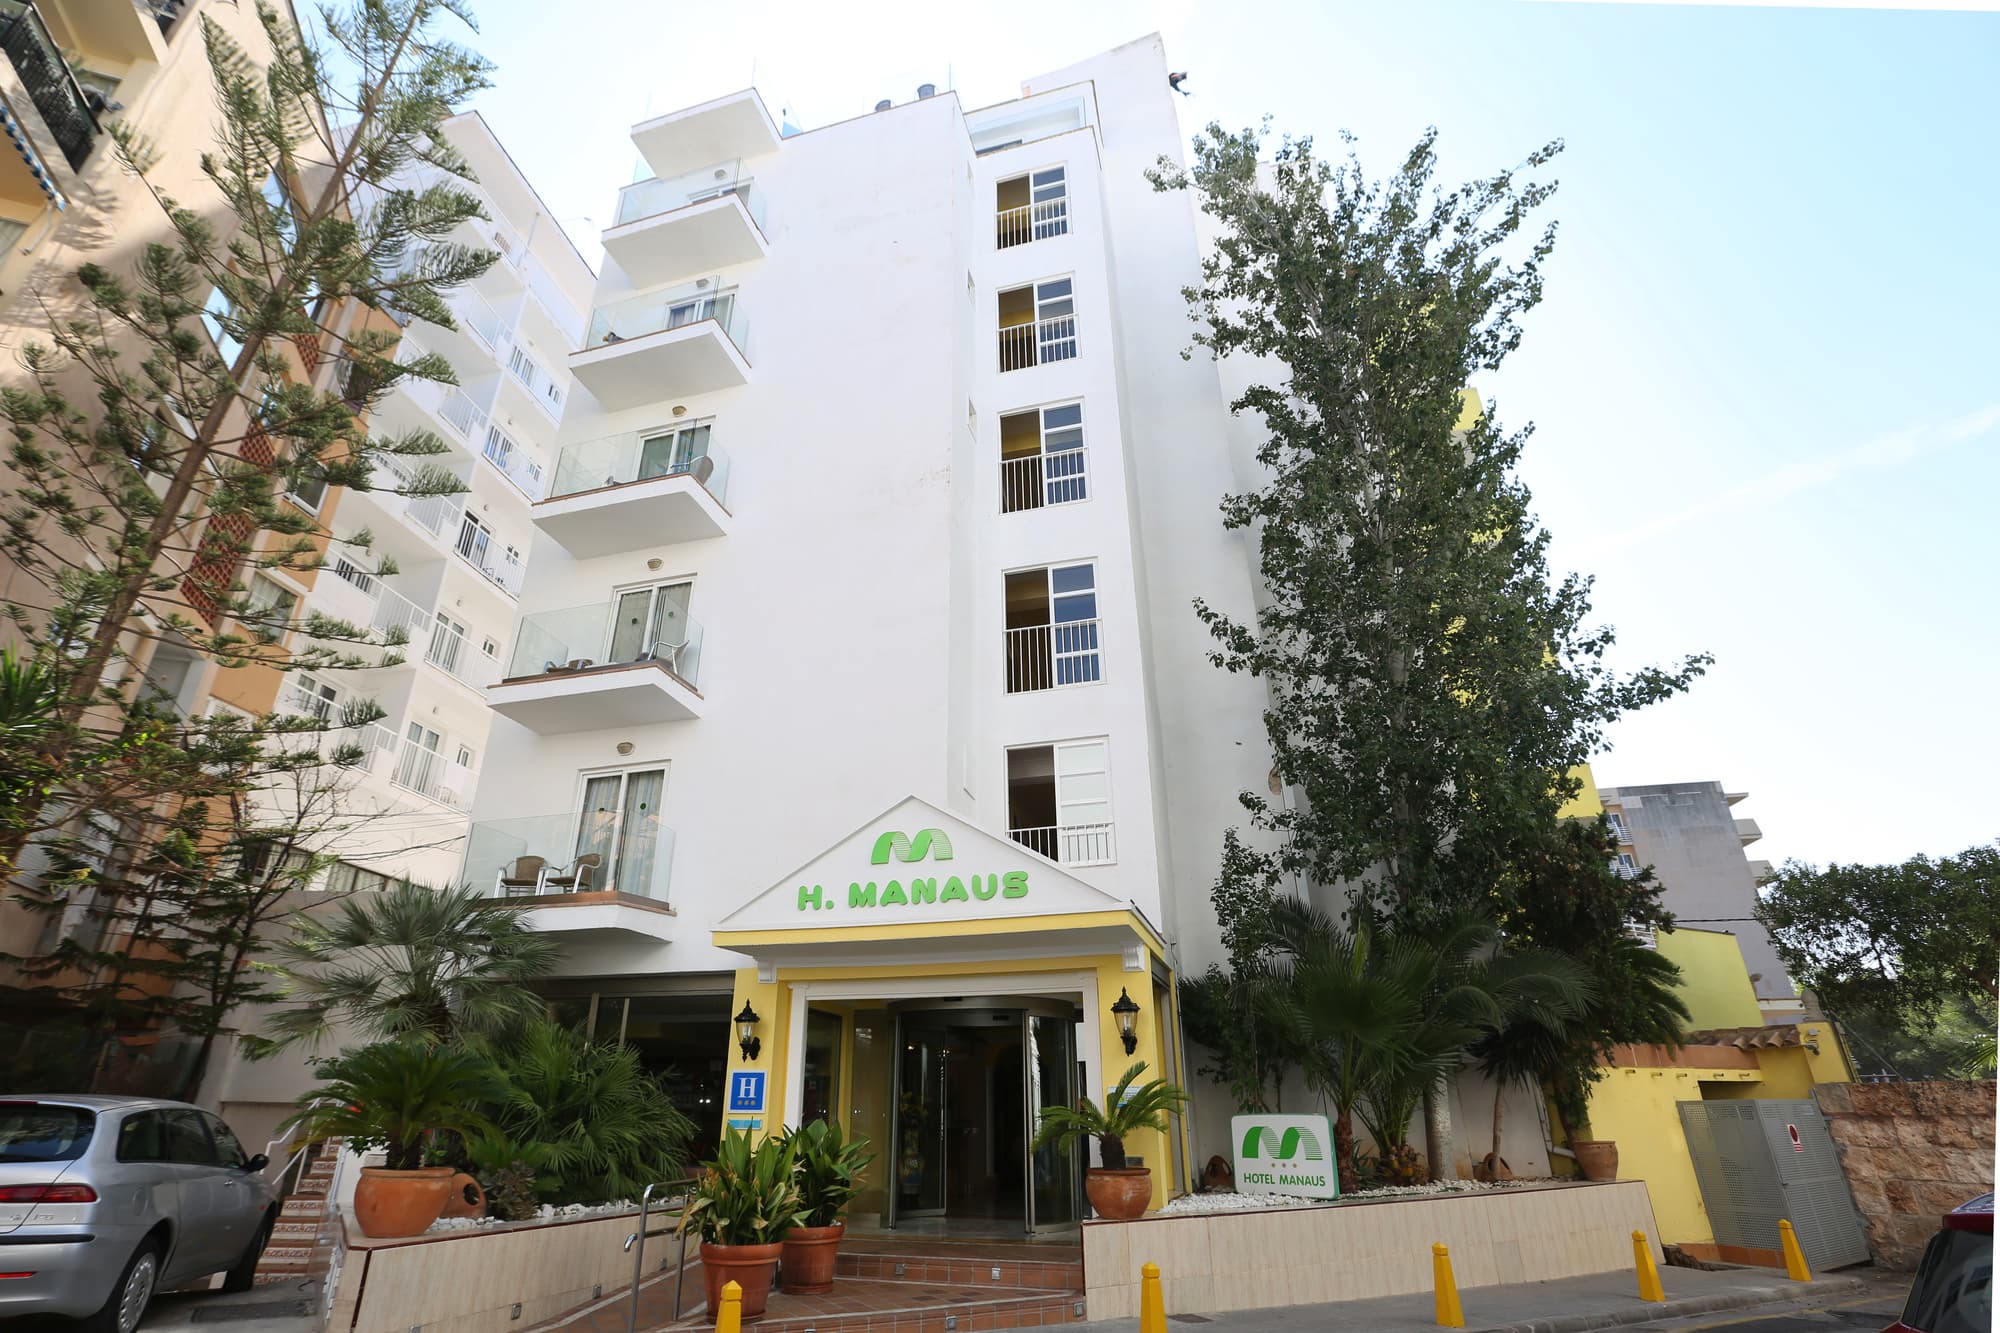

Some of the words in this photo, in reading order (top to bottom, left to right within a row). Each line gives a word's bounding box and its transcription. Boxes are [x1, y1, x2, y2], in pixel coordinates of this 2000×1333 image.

[798, 884, 834, 911] H.
[848, 870, 1029, 908] MANAUS
[737, 1077, 759, 1098] H
[1243, 1172, 1275, 1185] HOTEL
[1279, 1174, 1326, 1187] MANAUS
